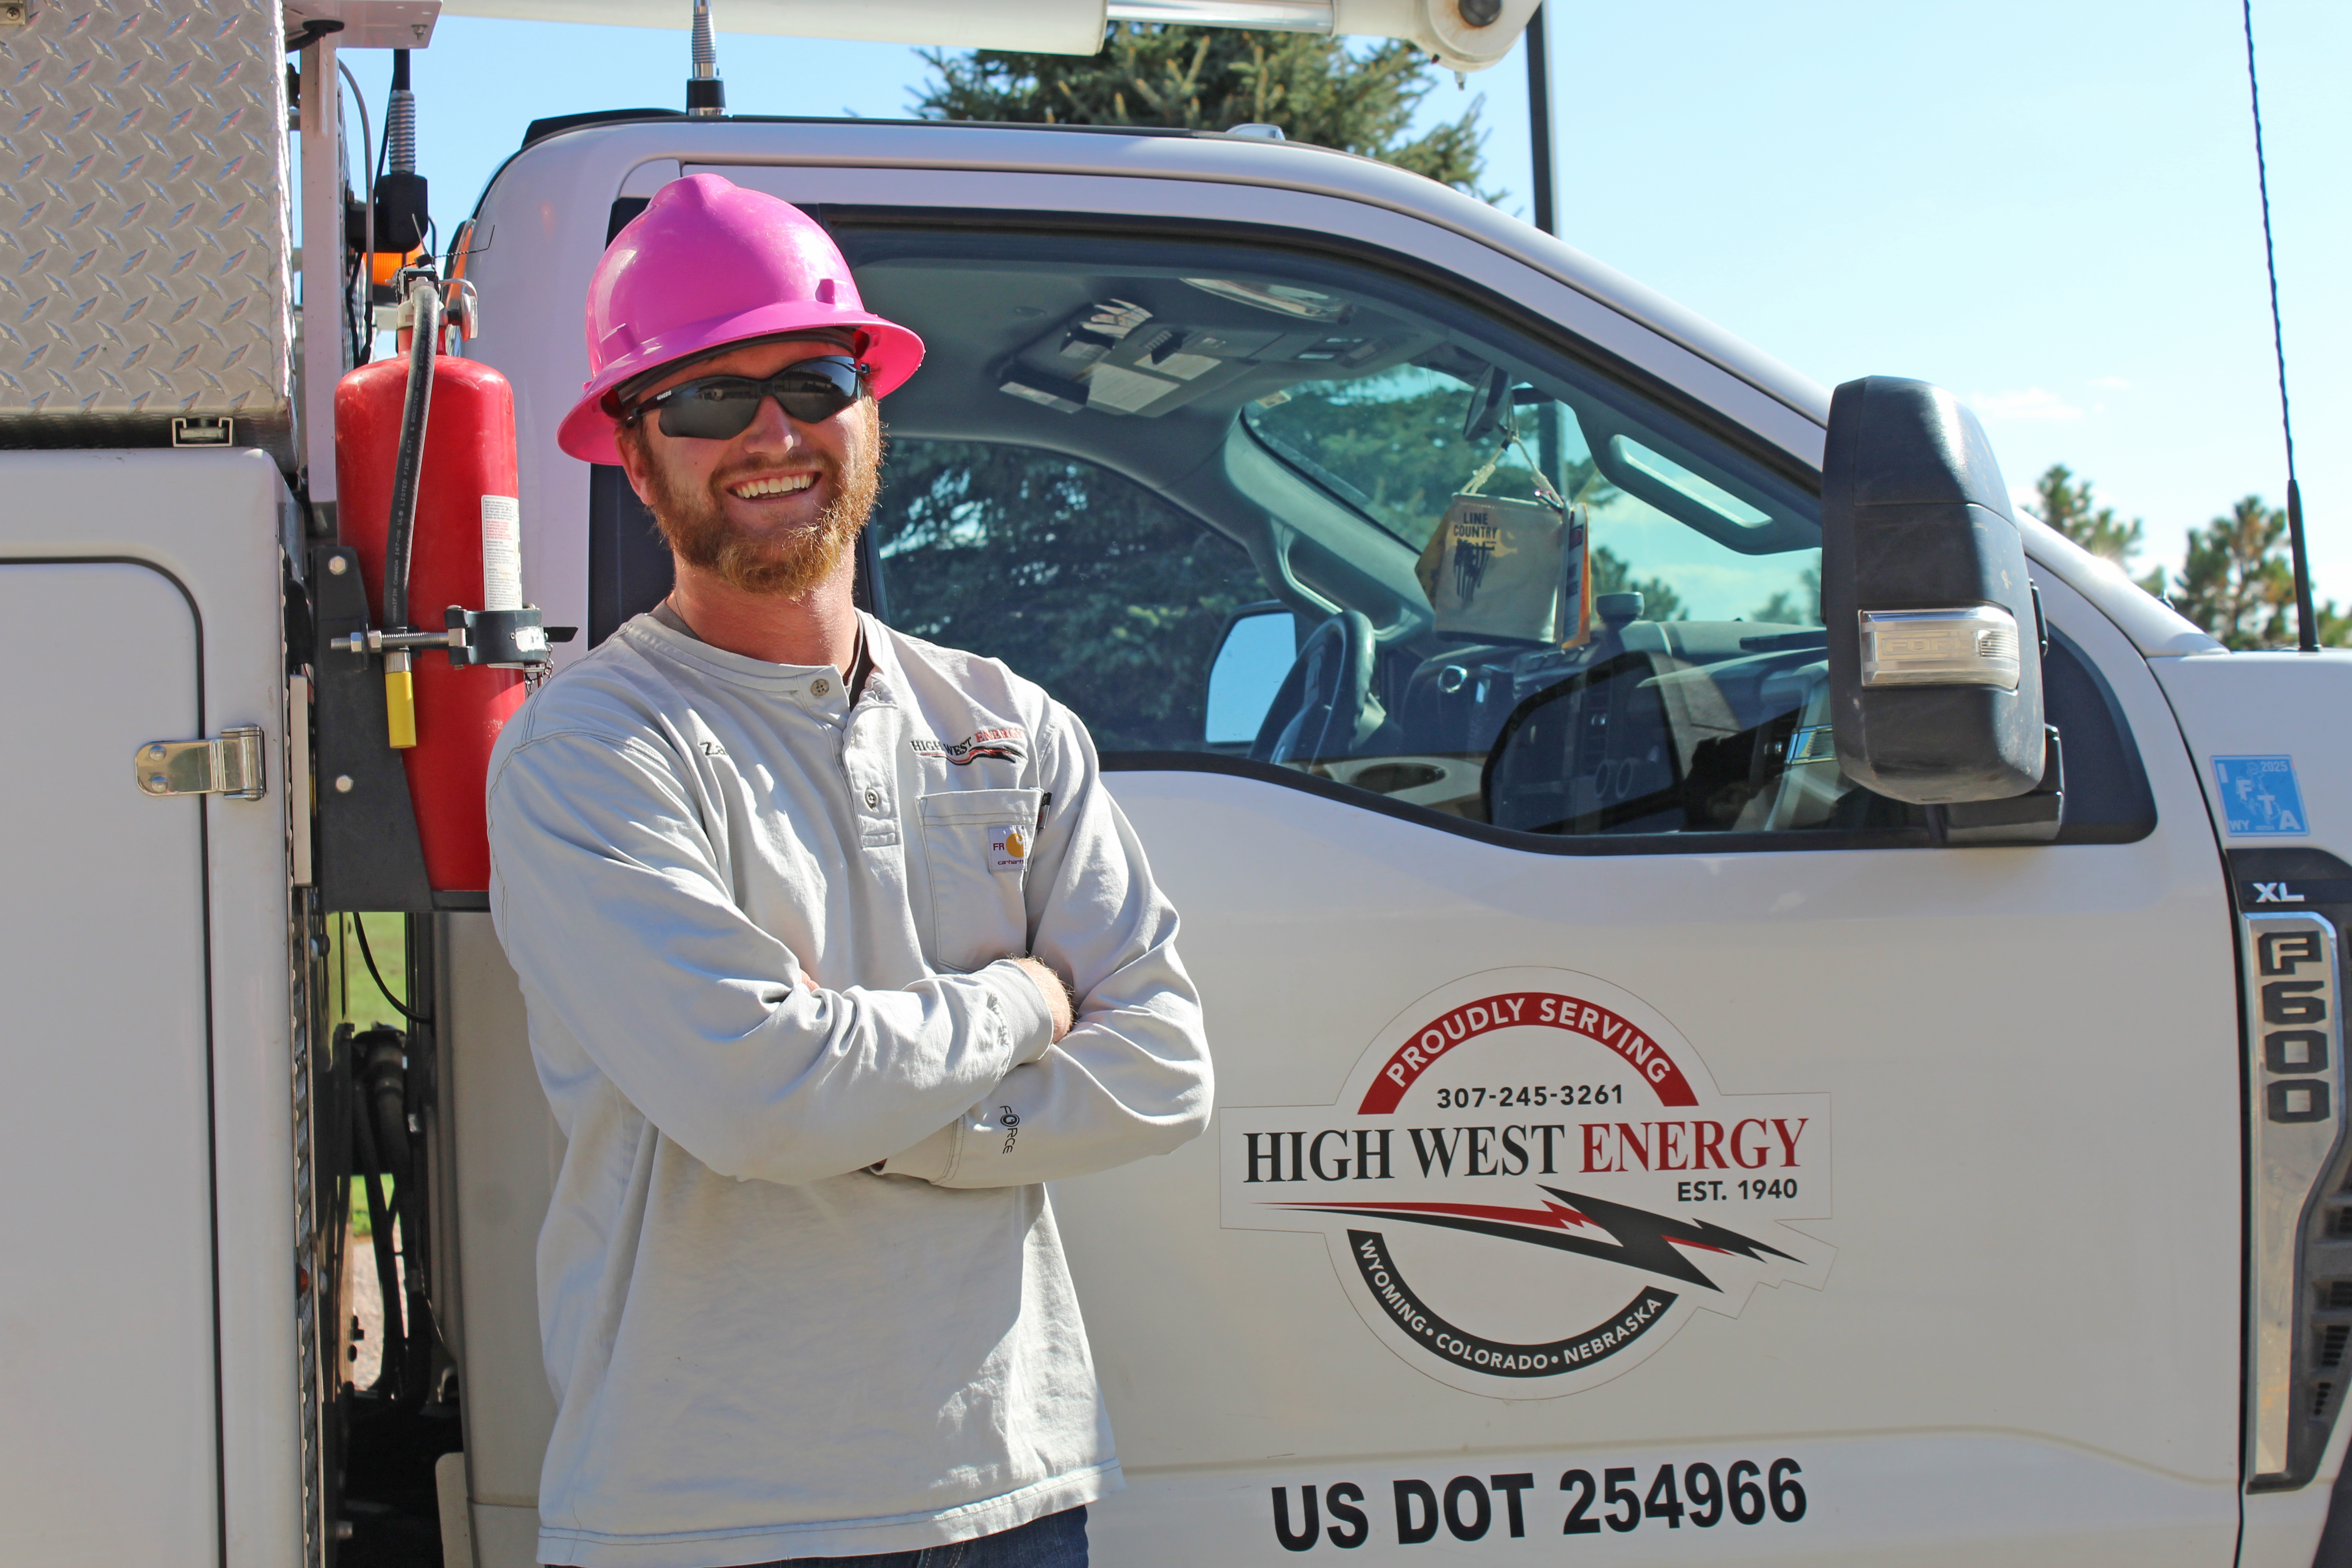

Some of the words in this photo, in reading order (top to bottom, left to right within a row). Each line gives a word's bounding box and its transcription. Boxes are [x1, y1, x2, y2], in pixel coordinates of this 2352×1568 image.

[1464, 512, 1488, 525] LINE
[1454, 524, 1497, 539] COUNTRY
[911, 740, 942, 752] HIGH
[943, 736, 972, 756] WEST
[975, 728, 1023, 743] ENERGY
[2261, 761, 2288, 772] 2025
[2229, 820, 2249, 831] WY
[993, 843, 1004, 851] FR
[2252, 882, 2305, 903] XL
[1387, 998, 1524, 1087] PROUDLY
[1540, 999, 1670, 1083] SERVING
[1437, 1085, 1623, 1109] 307-245-3261
[1000, 1106, 1019, 1154] FORCE
[1243, 1129, 1395, 1182] HIGH
[1407, 1125, 1565, 1178] WEST
[1579, 1118, 1809, 1172] ENERGY
[1678, 1181, 1727, 1202] EST.
[1738, 1179, 1798, 1200] 1940
[1361, 1240, 1426, 1332] WYOMING
[1436, 1333, 1548, 1370] COLORADO
[1564, 1299, 1661, 1364] NEBRASKA
[1272, 1482, 1368, 1552] US
[1393, 1473, 1534, 1545] DOT
[1559, 1458, 1807, 1535] 254966
